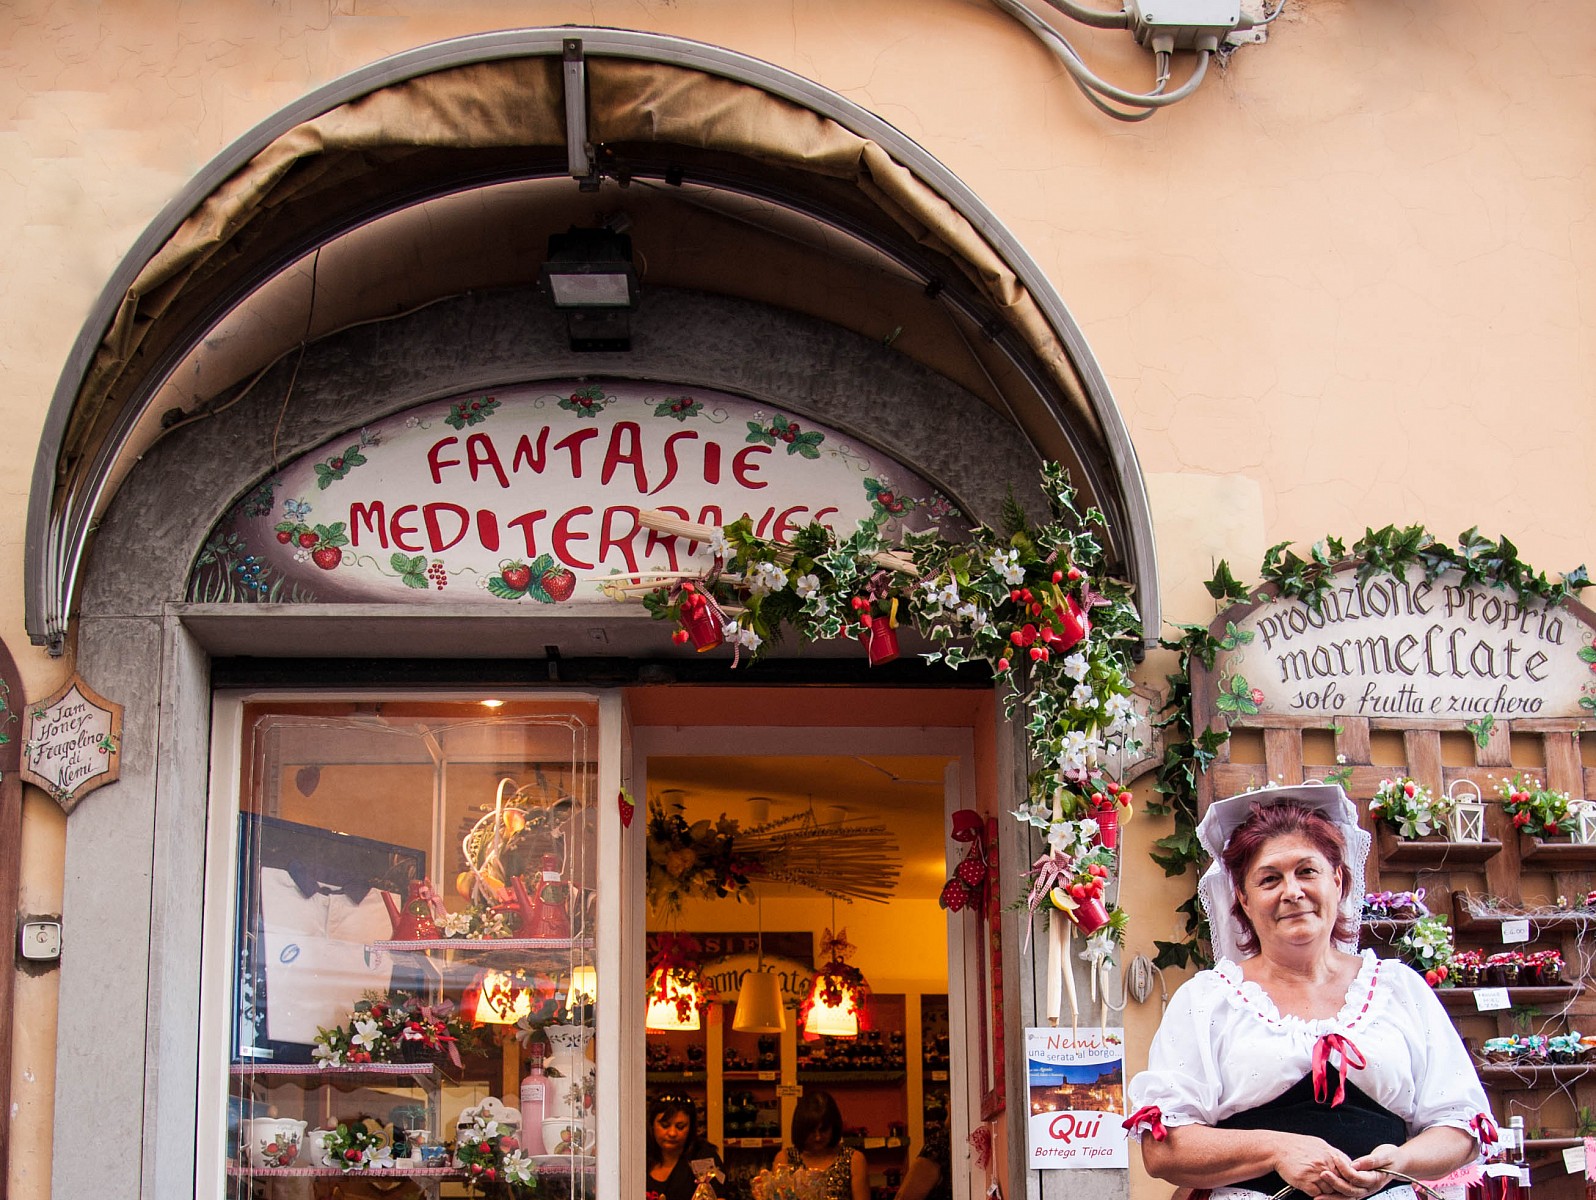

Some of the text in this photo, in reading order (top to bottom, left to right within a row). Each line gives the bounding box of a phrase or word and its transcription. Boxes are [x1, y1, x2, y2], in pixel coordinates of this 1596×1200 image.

[426, 421, 773, 494] FANTASIE
[1443, 583, 1566, 646] propria
[1276, 623, 1549, 683] marmellate
[1290, 681, 1545, 714] solo frutta e zucchero
[37, 713, 94, 741] Honey
[52, 702, 87, 723] Jam
[58, 757, 93, 787] Nemi
[68, 751, 81, 766] di
[1046, 1053, 1075, 1061] serata
[1078, 1050, 1086, 1059] al
[1047, 1034, 1099, 1050] Nemi
[1049, 1113, 1103, 1144] Qui
[1035, 1146, 1113, 1159] Bottega Tipica
